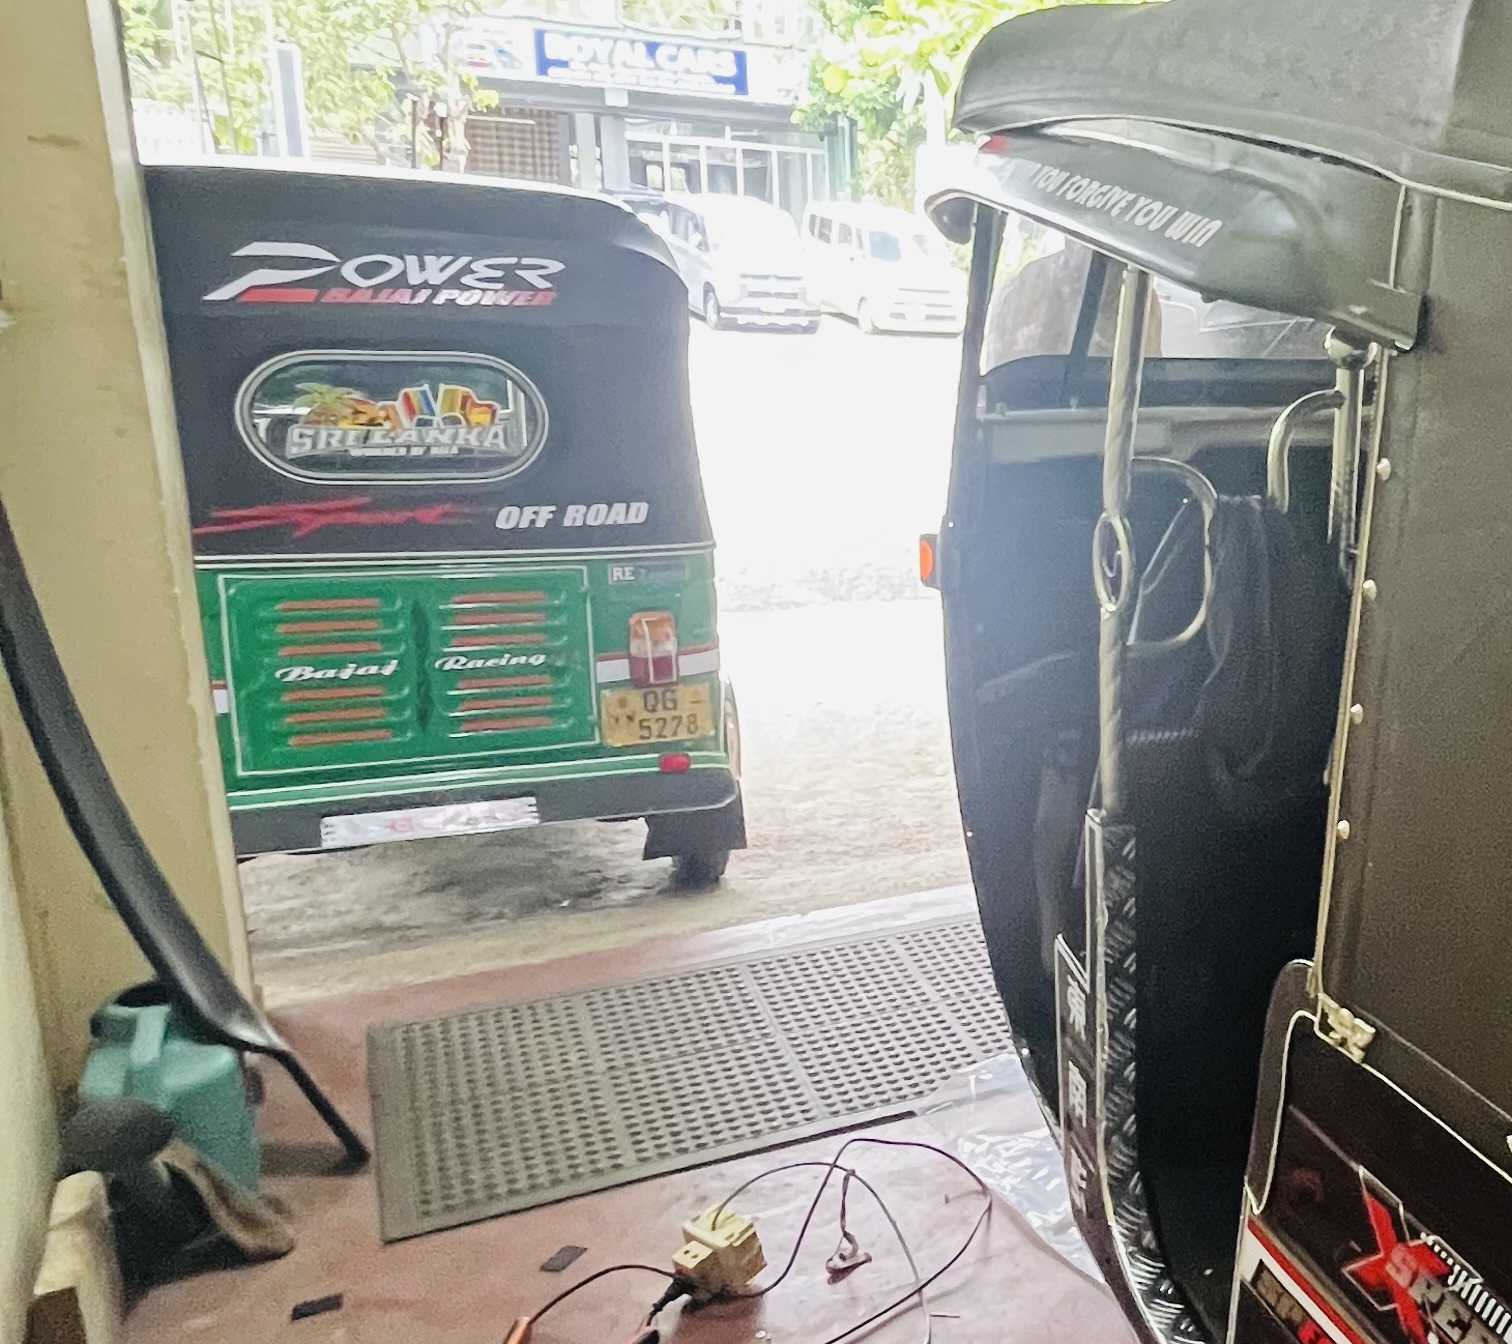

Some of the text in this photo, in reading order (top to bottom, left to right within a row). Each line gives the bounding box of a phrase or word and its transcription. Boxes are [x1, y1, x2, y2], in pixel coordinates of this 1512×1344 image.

[1056, 175, 1136, 218] FORGIVE
[1124, 195, 1179, 232] YOU
[1164, 210, 1223, 248] WIN
[202, 241, 566, 302] POWER
[432, 288, 556, 306] POWER
[495, 504, 556, 529] OFF
[563, 502, 649, 527] ROAD
[612, 566, 635, 582] RE
[275, 654, 546, 682] Bajaj Racing
